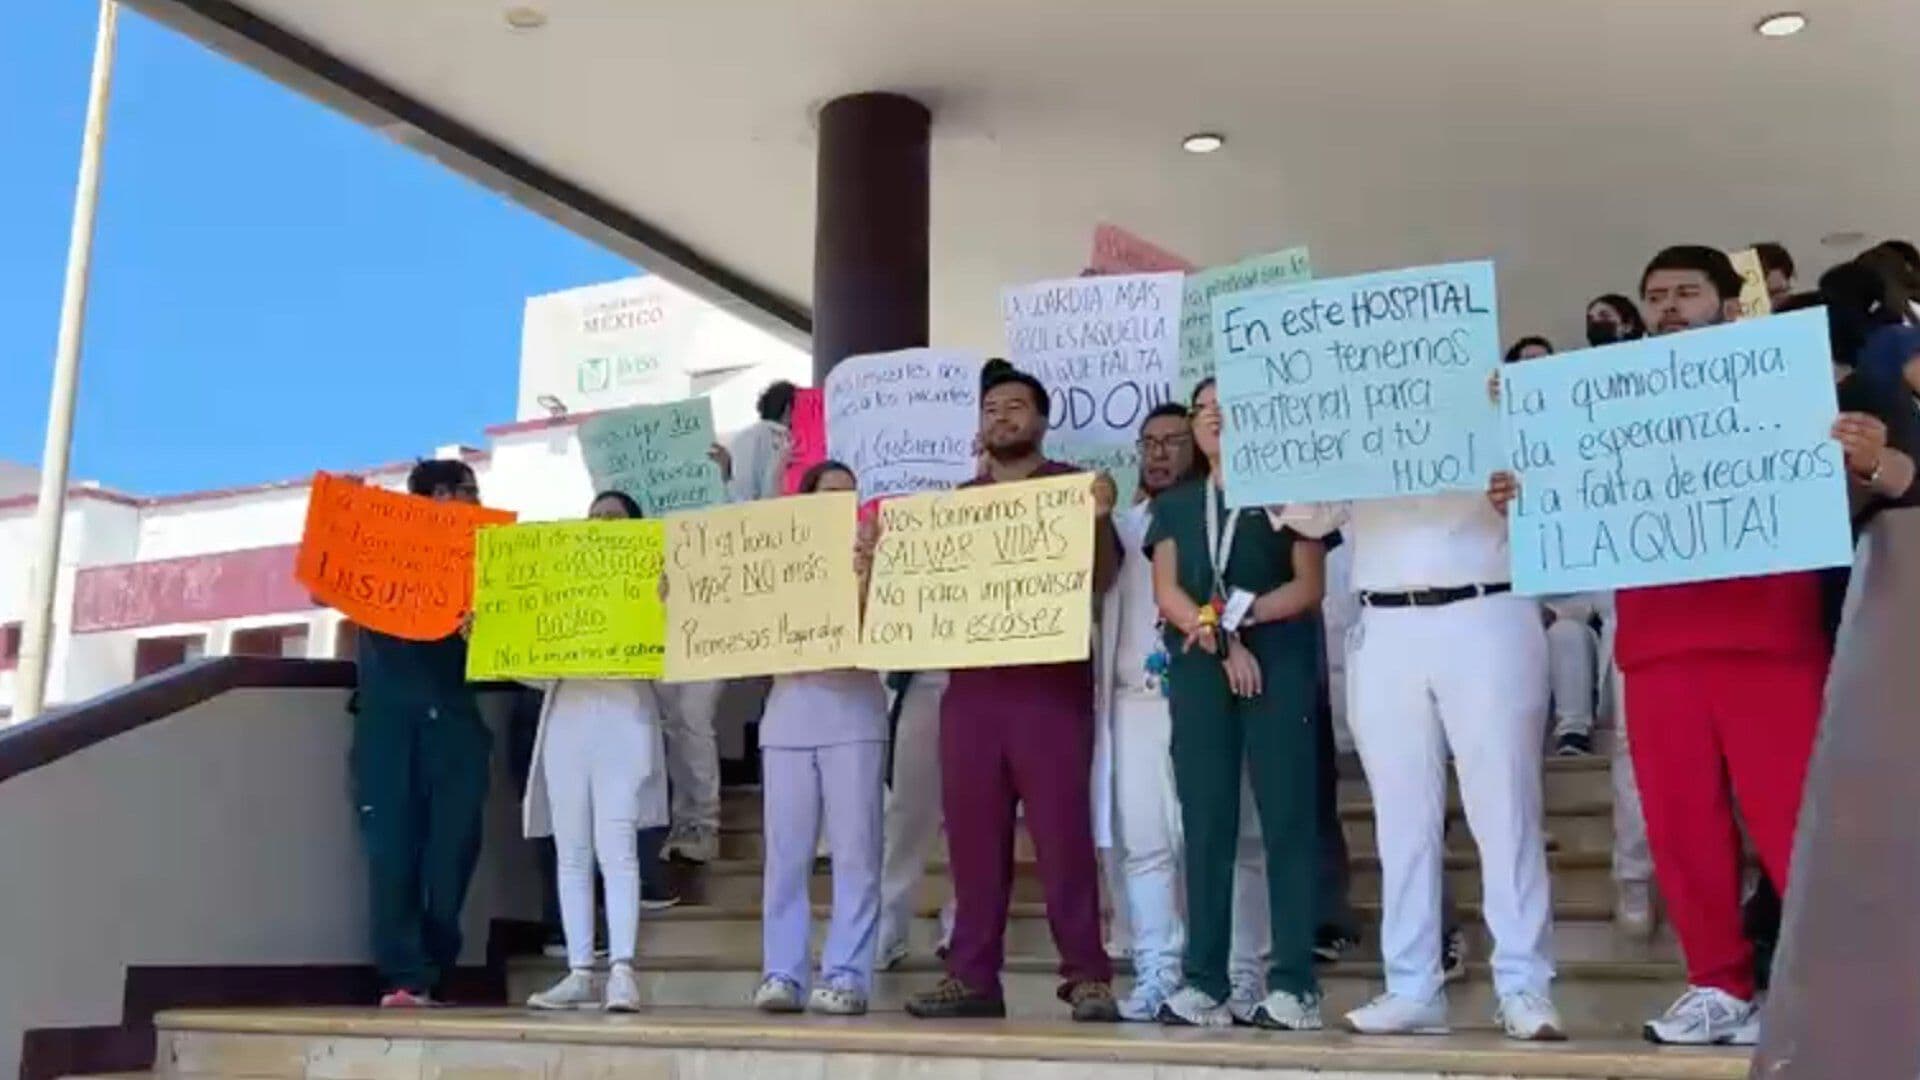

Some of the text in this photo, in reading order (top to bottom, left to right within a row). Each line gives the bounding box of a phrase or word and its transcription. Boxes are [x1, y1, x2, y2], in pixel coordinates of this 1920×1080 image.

[1222, 307, 1271, 354] En
[1282, 298, 1345, 337] este
[1352, 281, 1490, 329] HOSPITAL
[1265, 327, 1471, 389] NO tenemos
[1231, 377, 1431, 433] material para
[1505, 376, 1546, 417] La
[1232, 428, 1352, 475] atender
[1512, 430, 1554, 473] da
[1516, 440, 1835, 518] La falta de recursos
[877, 514, 1069, 569] SALVAR VIDAS
[741, 560, 776, 596] NO
[869, 618, 914, 645] con
